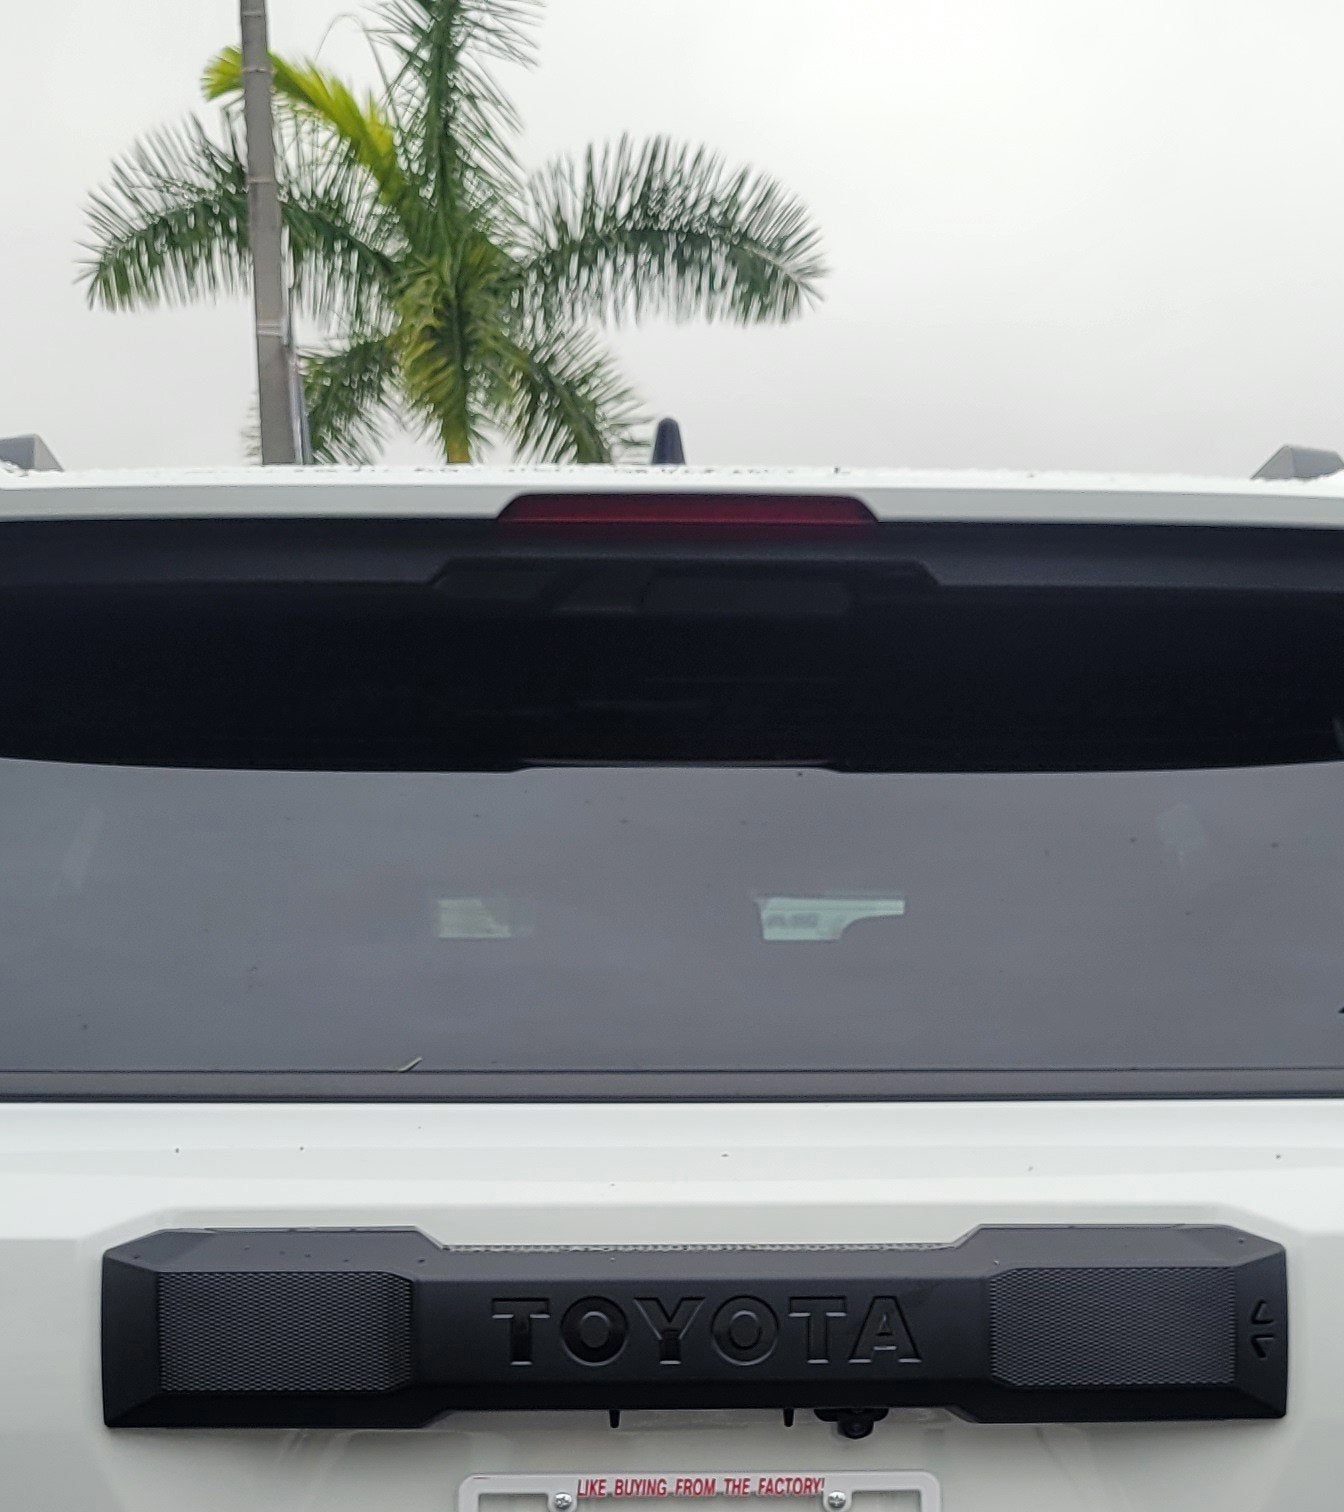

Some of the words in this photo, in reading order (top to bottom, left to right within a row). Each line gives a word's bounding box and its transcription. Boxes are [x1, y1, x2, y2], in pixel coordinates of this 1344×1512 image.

[491, 1294, 923, 1367] TOYOTA
[576, 1478, 606, 1497] LIKE
[613, 1478, 668, 1497] BUYING
[674, 1477, 717, 1496] FROM
[723, 1477, 752, 1496] THE
[757, 1476, 826, 1496] FACTORY!
